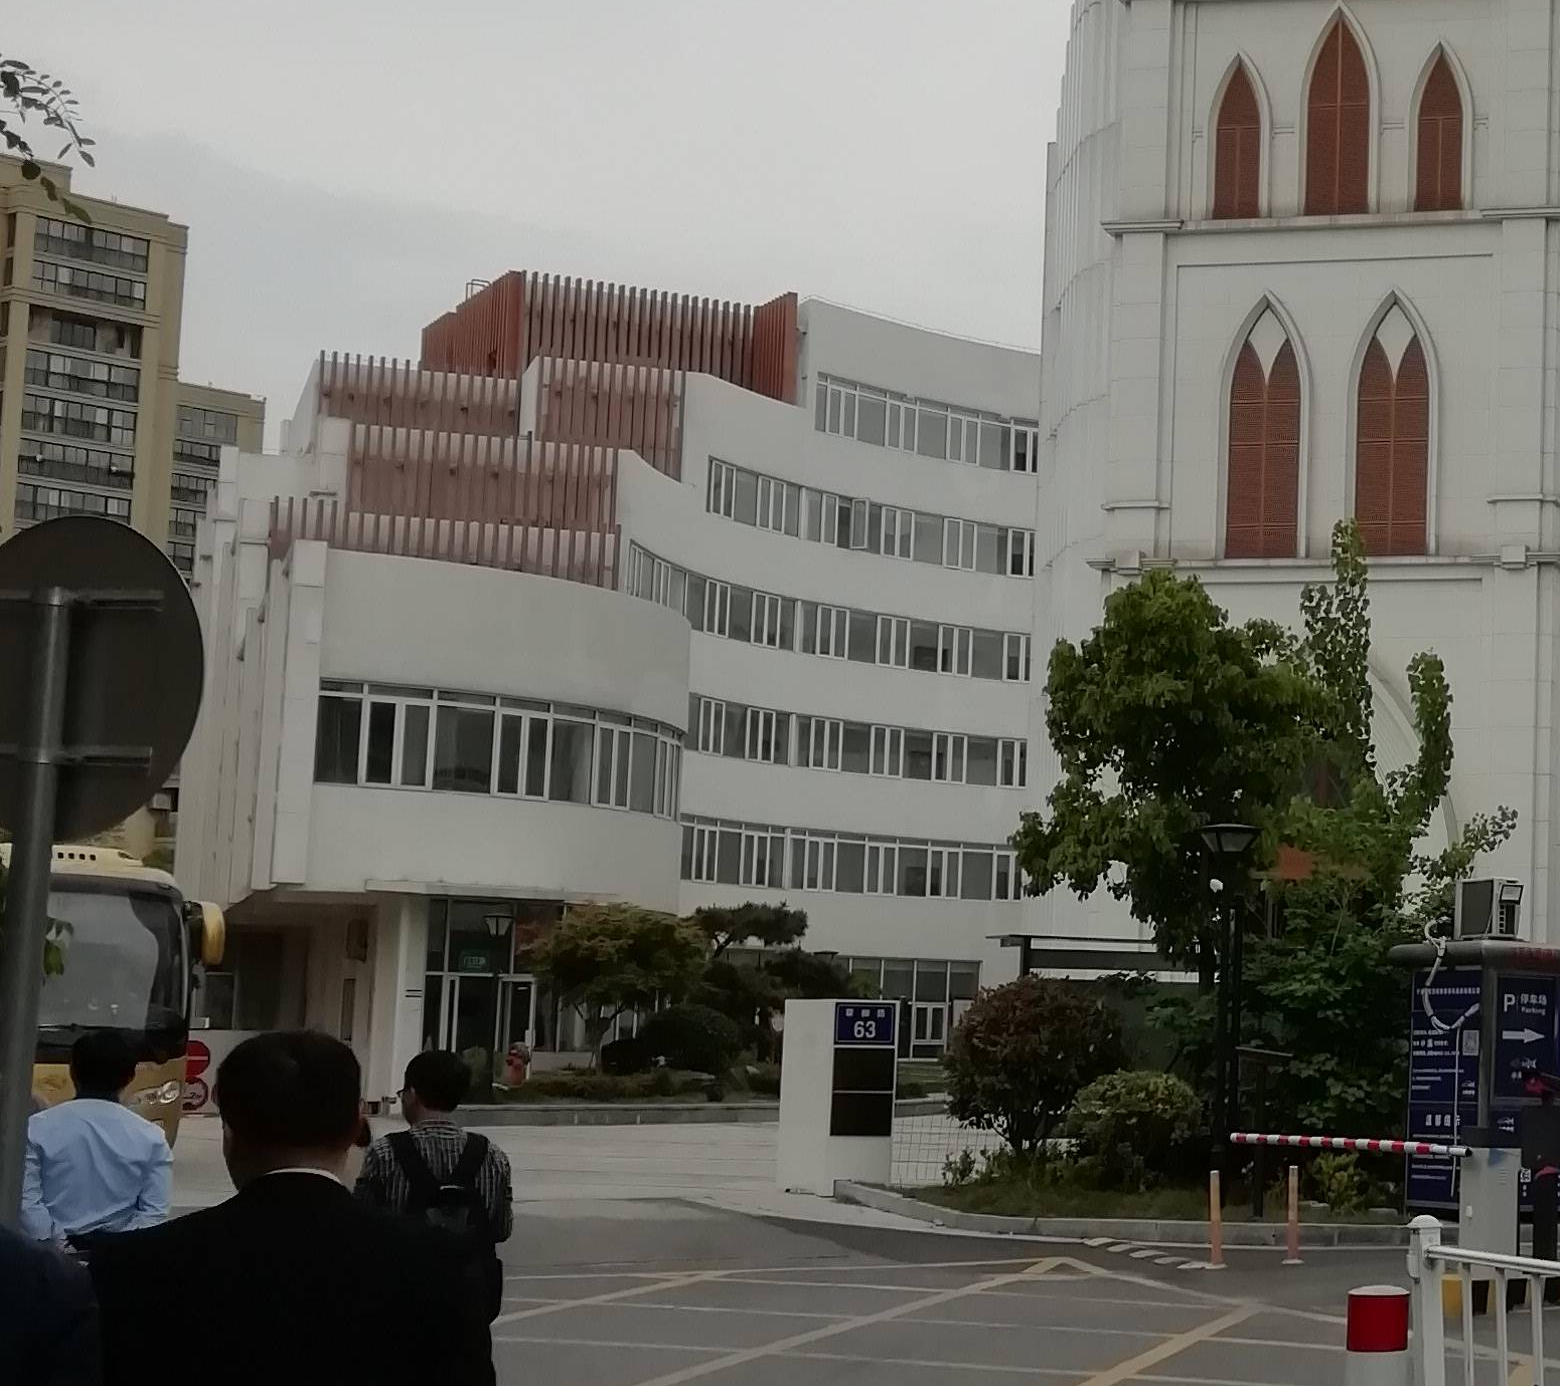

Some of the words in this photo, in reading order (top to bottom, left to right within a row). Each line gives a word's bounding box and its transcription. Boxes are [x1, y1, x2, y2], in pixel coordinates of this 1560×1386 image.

[1503, 993, 1516, 1013] P
[1520, 993, 1547, 1006] 停车场
[1521, 1006, 1546, 1016] Parking
[854, 1021, 876, 1038] 63
